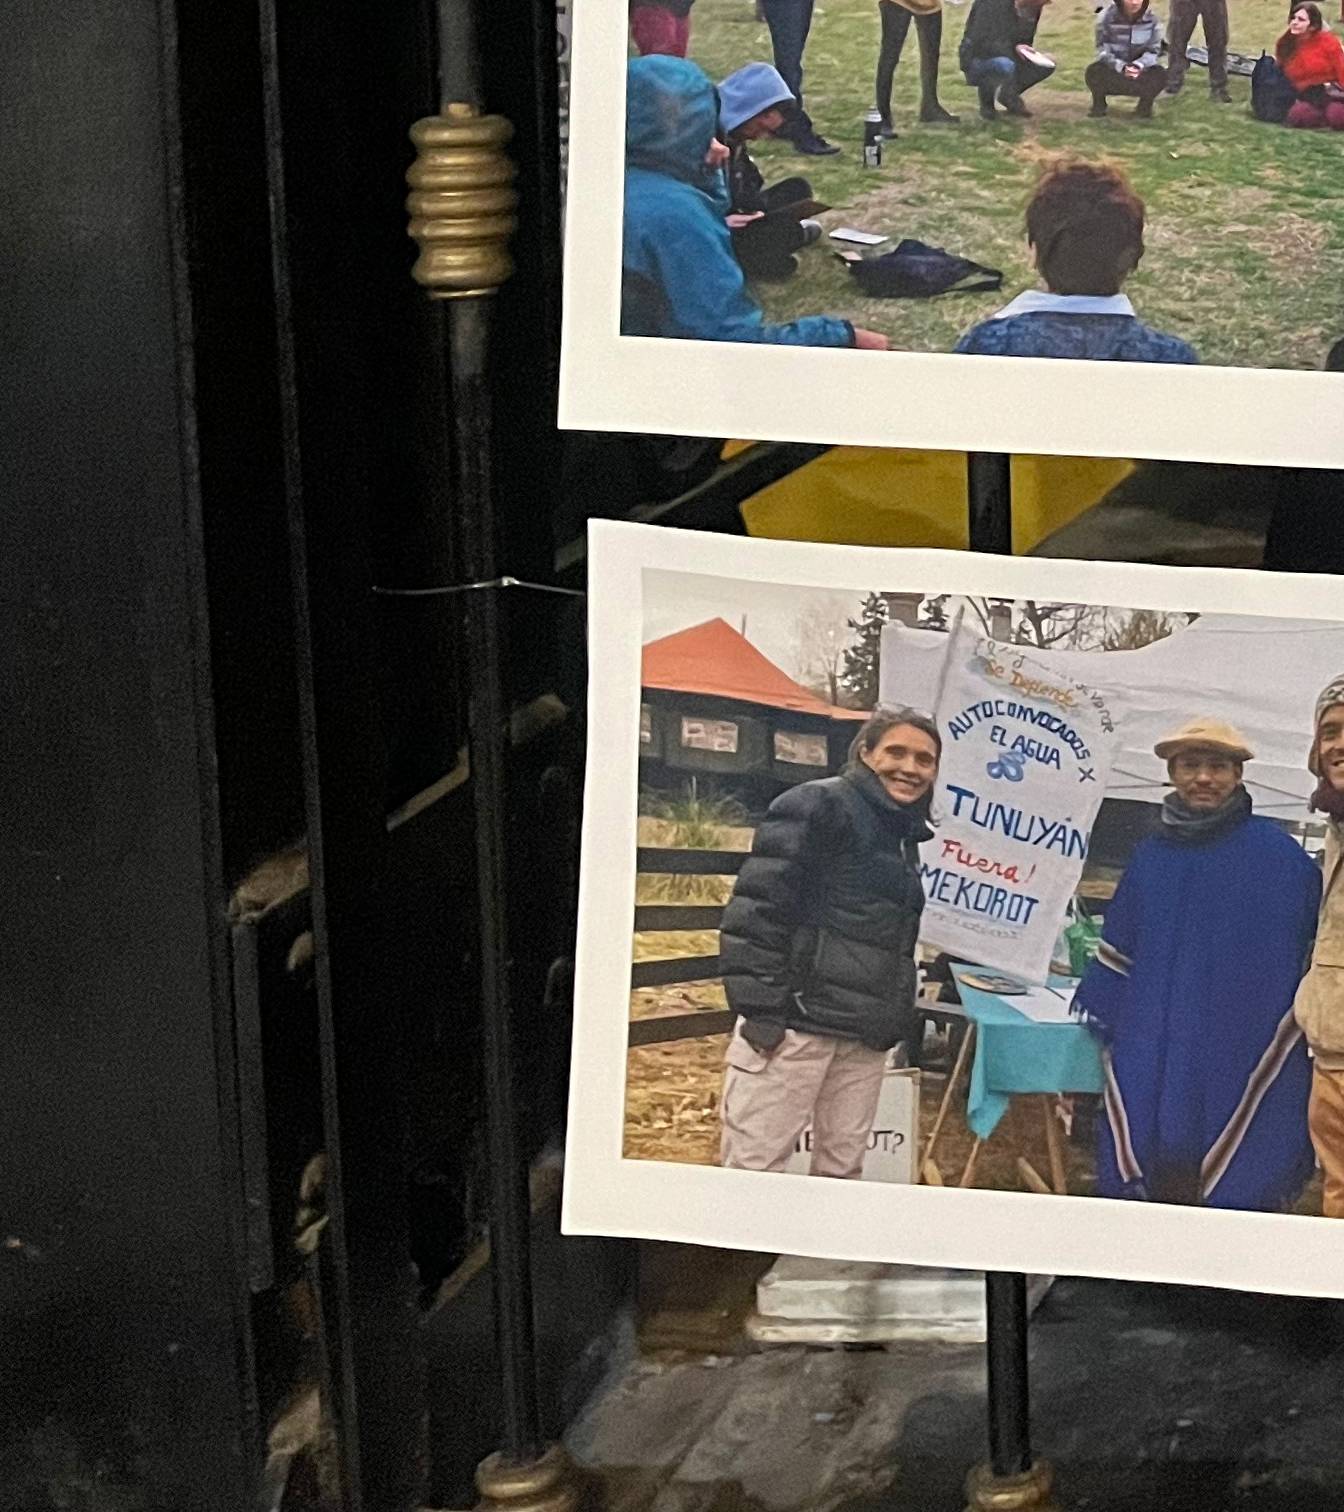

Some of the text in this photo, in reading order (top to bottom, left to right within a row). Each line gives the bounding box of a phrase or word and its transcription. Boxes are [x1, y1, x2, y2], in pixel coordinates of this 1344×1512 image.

[947, 699, 1091, 761] AUTOCONVOCADOS
[989, 724, 1061, 771] EL AGUA
[920, 862, 1040, 925] MEKOROT
